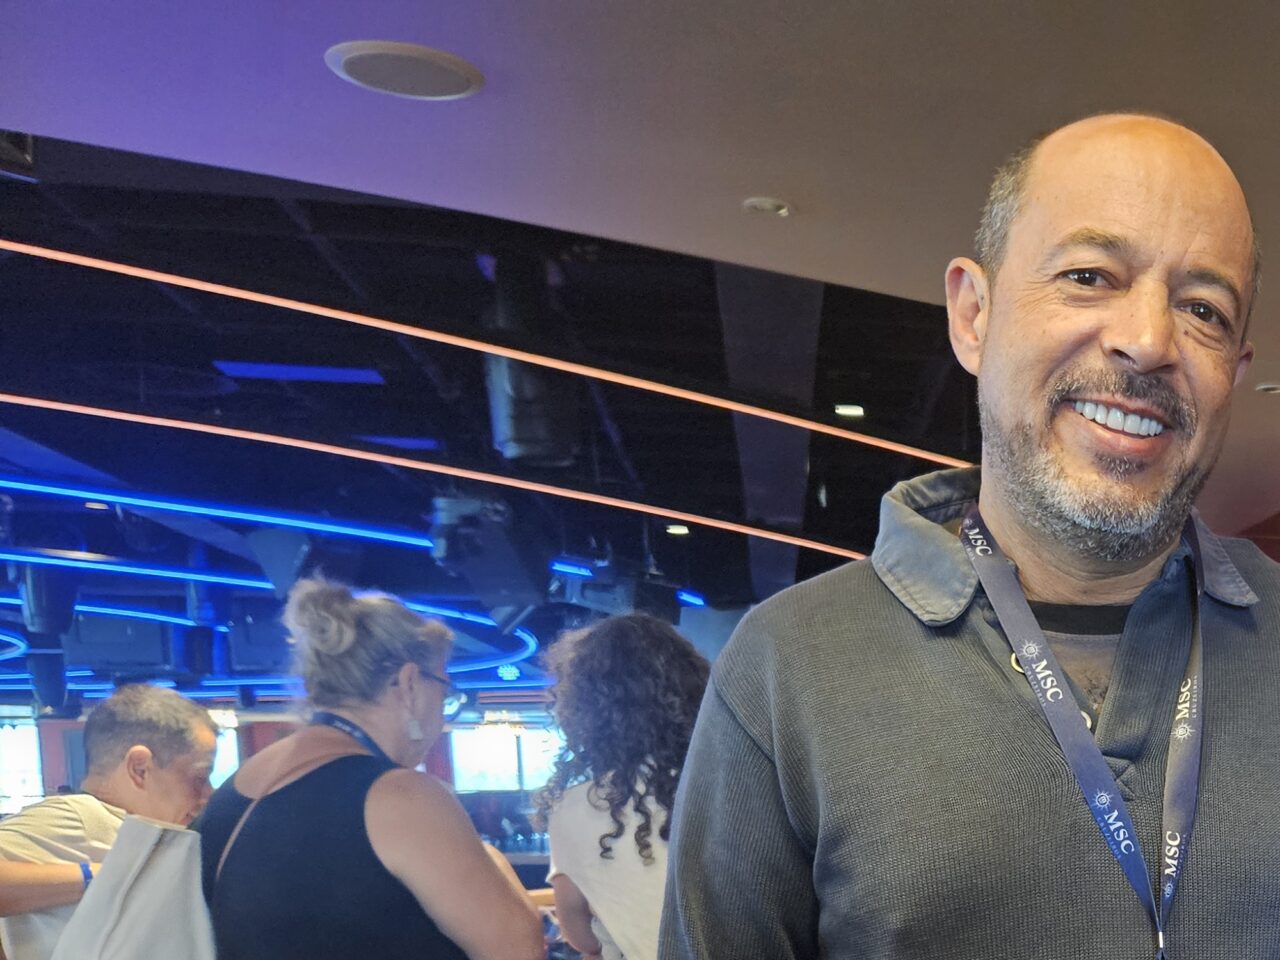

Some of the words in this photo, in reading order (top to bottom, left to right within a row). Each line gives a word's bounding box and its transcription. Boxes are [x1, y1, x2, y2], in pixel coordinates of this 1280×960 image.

[965, 528, 992, 556] MSC
[1031, 659, 1063, 702] MSC
[1175, 678, 1191, 720] MSC
[1104, 810, 1134, 854] MSC
[1165, 831, 1180, 877] MSC
